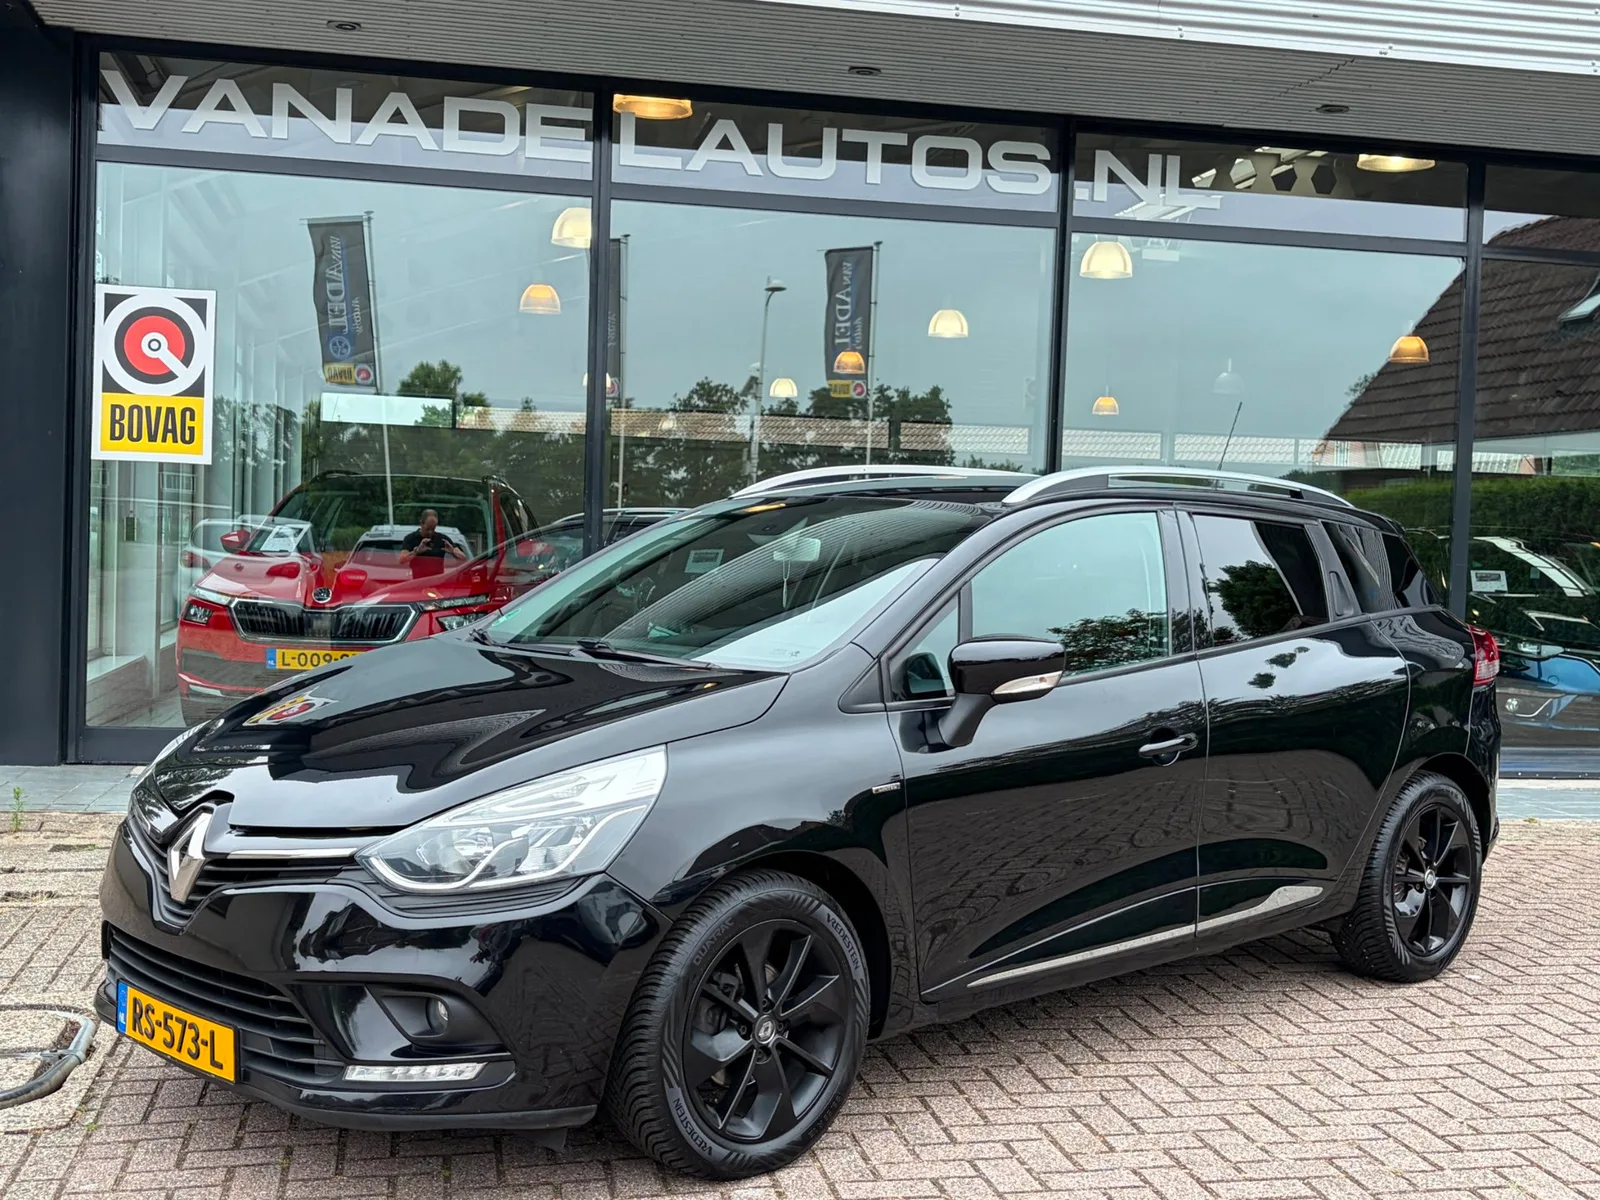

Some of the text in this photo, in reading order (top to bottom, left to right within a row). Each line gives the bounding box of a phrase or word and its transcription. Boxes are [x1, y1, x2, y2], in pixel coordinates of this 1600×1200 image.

[109, 403, 196, 445] BOVAG
[693, 917, 736, 967] QUATRAC
[826, 912, 861, 971] VREDESTEIN
[132, 997, 224, 1070] RS-573-L
[673, 1097, 714, 1157] VREDESTEIN
